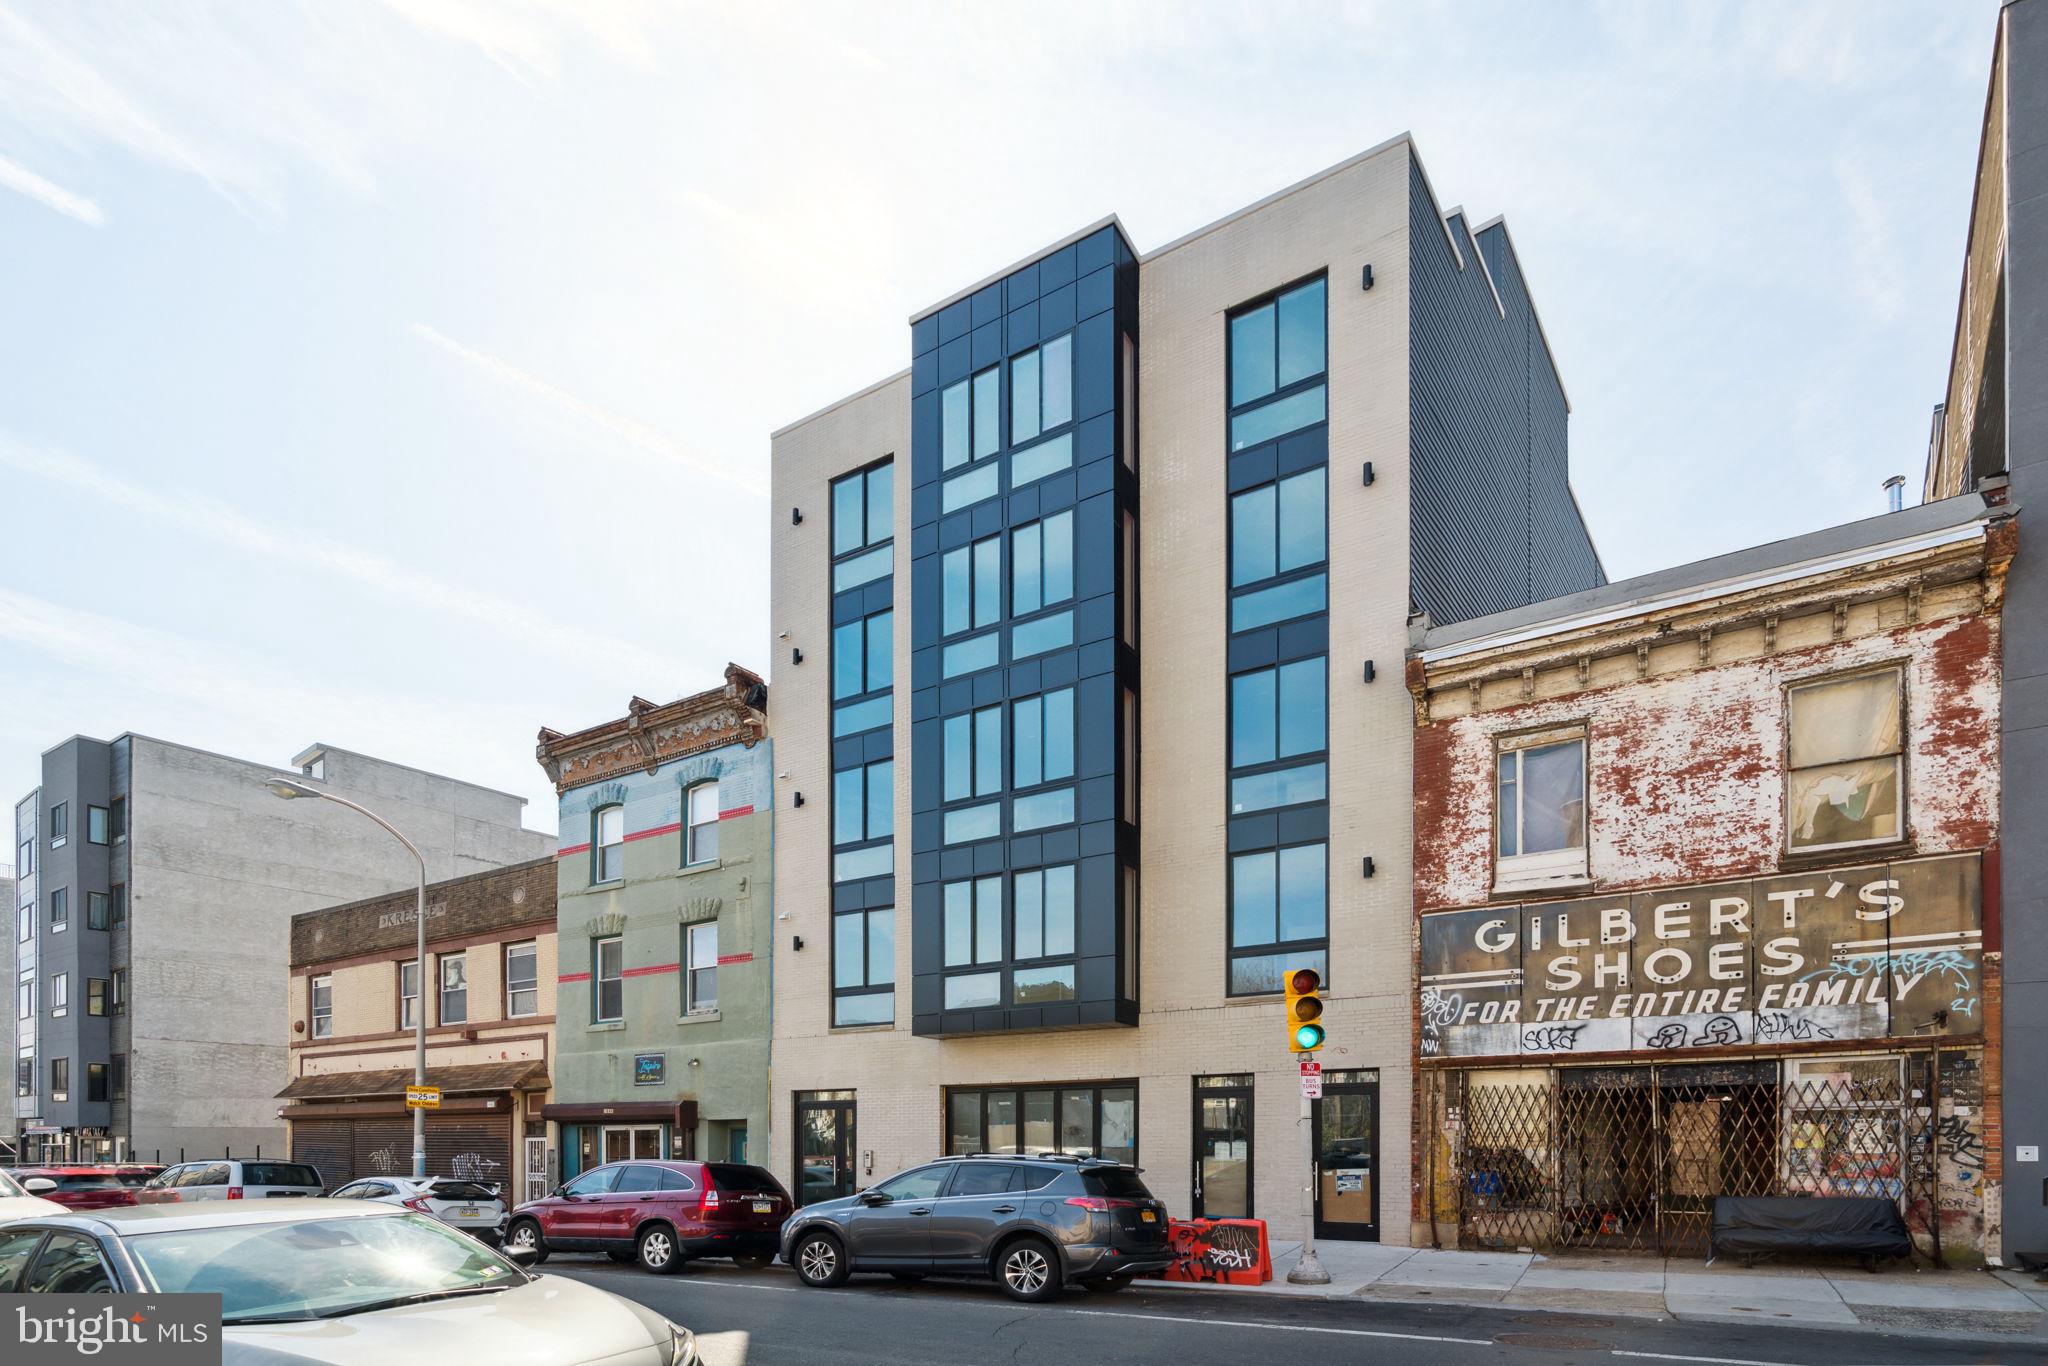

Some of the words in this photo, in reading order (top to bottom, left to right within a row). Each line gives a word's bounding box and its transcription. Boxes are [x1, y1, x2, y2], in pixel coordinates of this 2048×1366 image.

[1475, 880, 1904, 953] GILBERT'S
[1545, 938, 1804, 991] SHOES
[1458, 1000, 1521, 1025] FOR
[1536, 996, 1598, 1021] THE
[1608, 986, 1745, 1018] ENTIRE
[1758, 973, 1925, 1010] FAMILY
